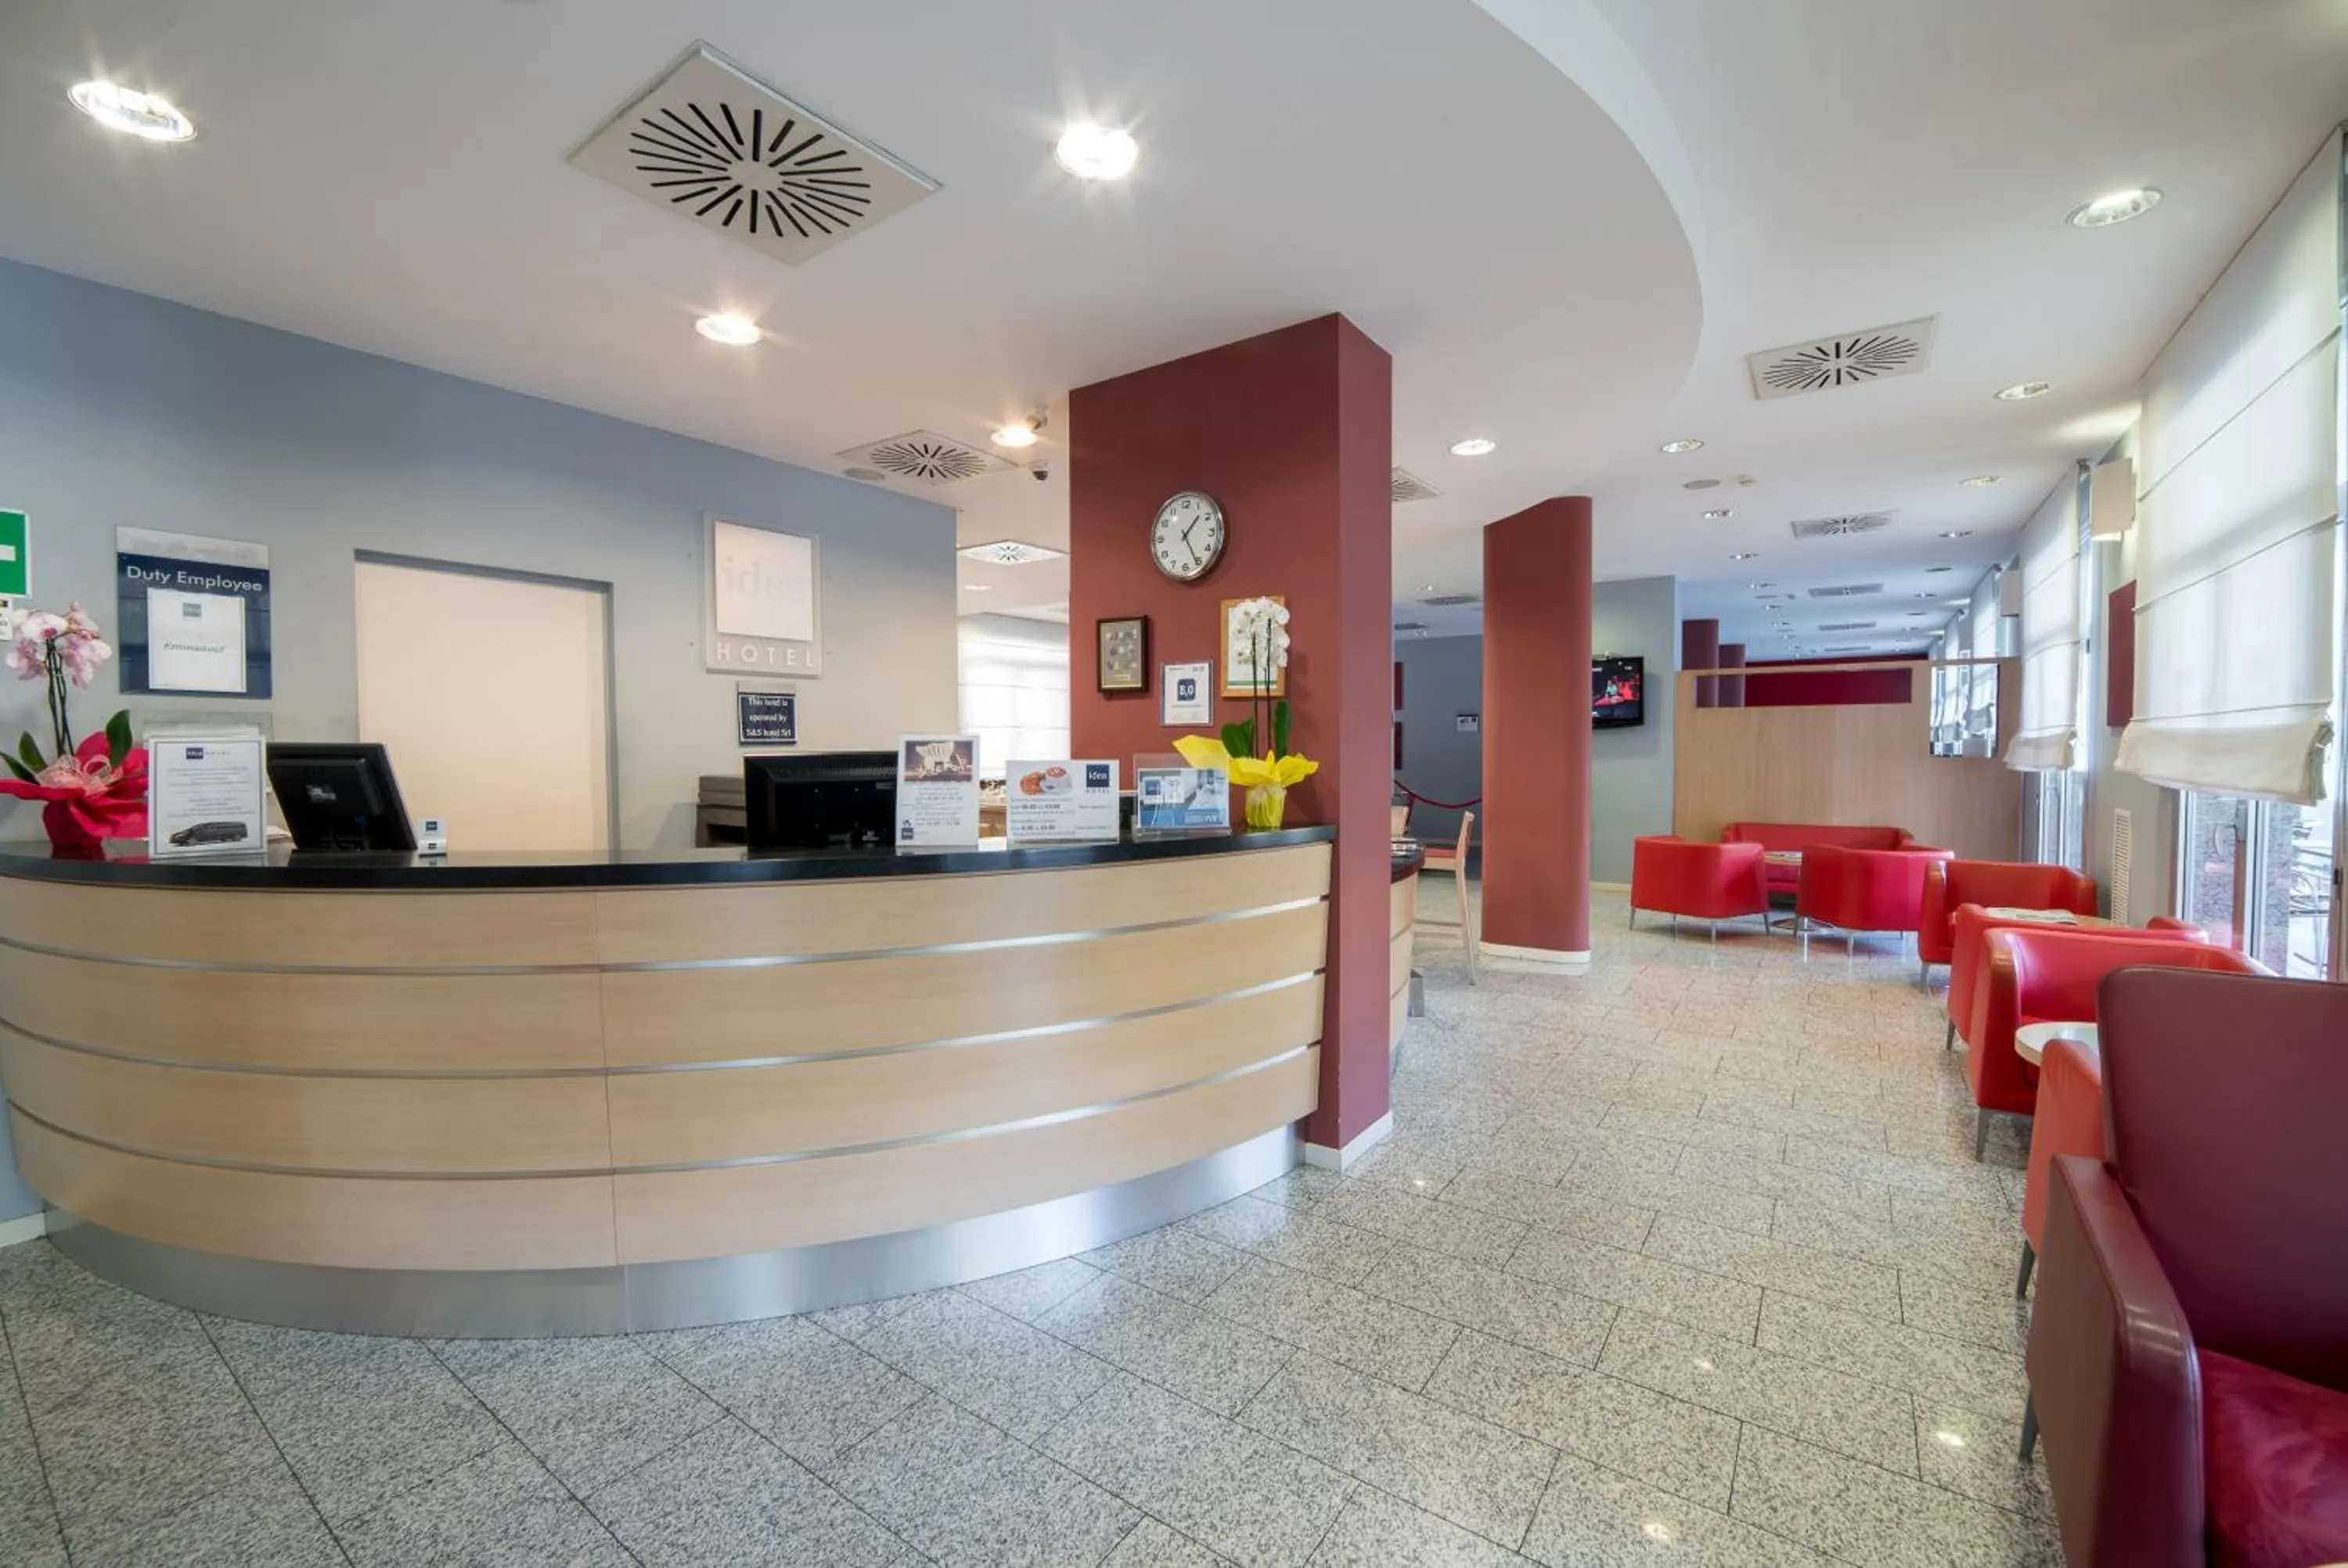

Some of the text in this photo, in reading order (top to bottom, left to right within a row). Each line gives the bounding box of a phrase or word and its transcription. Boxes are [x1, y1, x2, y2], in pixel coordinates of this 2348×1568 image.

[1171, 508, 1176, 516] 11
[1205, 512, 1212, 521] 2
[1161, 519, 1169, 528] 10
[1208, 527, 1215, 538] 3
[1157, 534, 1165, 544] 9
[1161, 550, 1169, 559] 8
[1170, 559, 1176, 569] 7
[1196, 556, 1202, 565] 5
[1182, 563, 1189, 571] 6
[127, 566, 262, 592] Duty Employee
[717, 643, 814, 667] HOTEL
